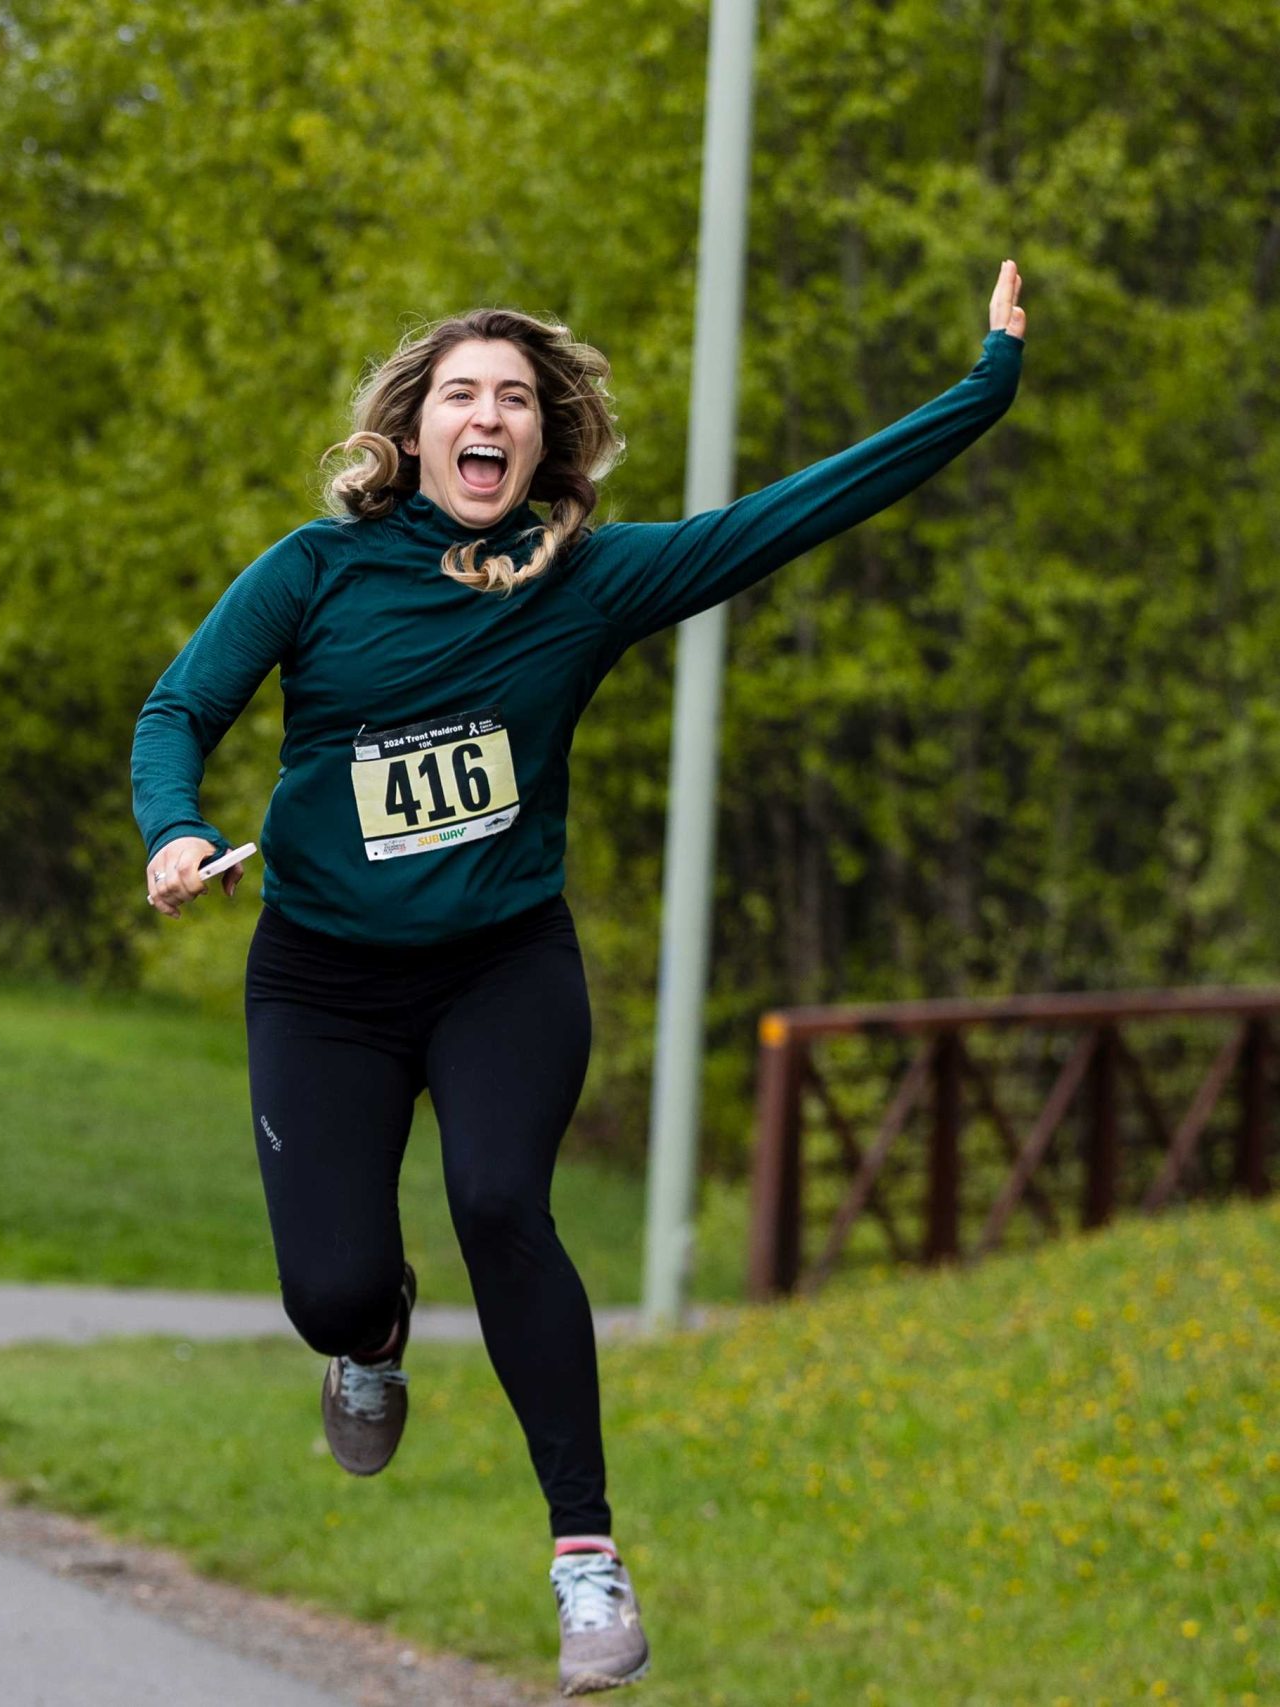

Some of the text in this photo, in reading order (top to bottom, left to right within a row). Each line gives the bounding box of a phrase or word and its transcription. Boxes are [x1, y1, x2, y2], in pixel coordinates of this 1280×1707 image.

[384, 723, 464, 749] 2024 Trent Waldron
[418, 740, 432, 749] 10K
[385, 743, 492, 826] 416
[418, 828, 467, 846] SUBWAY
[261, 1115, 277, 1143] CRAFT
